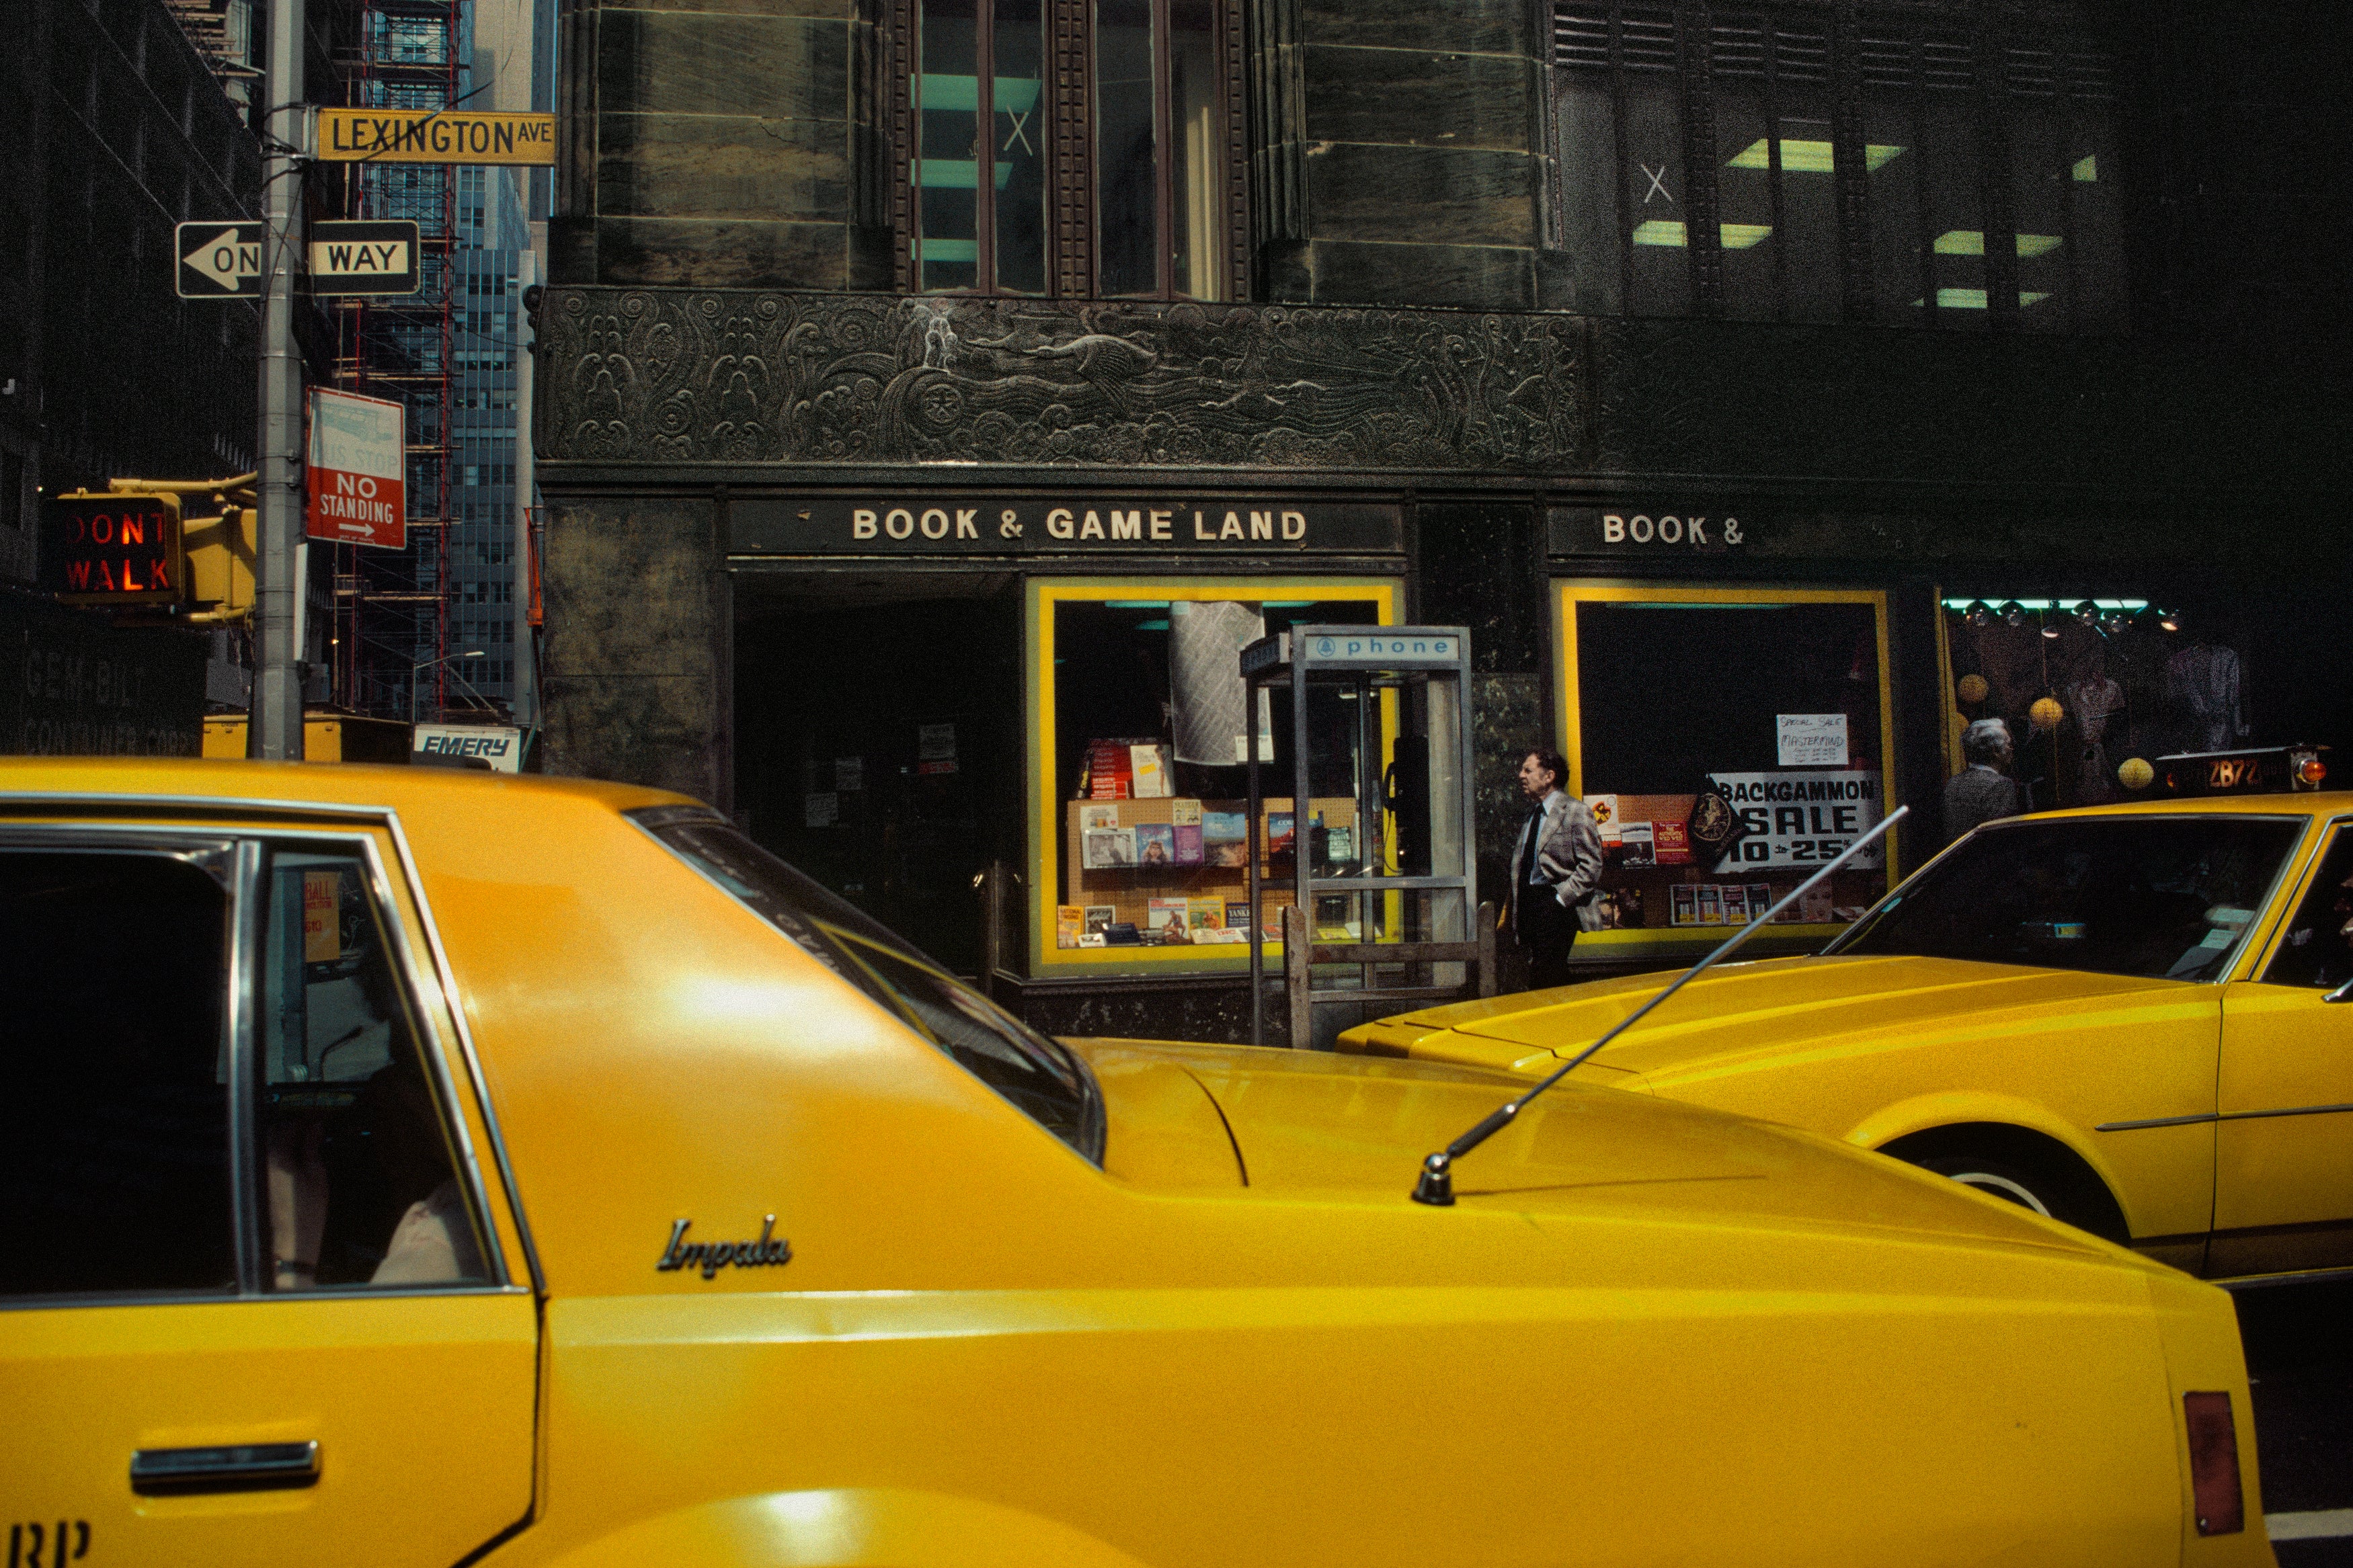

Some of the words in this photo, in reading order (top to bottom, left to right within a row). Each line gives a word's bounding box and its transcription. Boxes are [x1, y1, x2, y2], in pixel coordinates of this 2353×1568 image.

[333, 118, 514, 154] LEXINGTON
[516, 122, 553, 142] AVE
[214, 245, 260, 273] ON
[328, 244, 399, 272] WAY
[337, 472, 378, 499] NO
[319, 493, 395, 524] STANDING
[66, 513, 165, 545] DONT
[853, 509, 979, 540] BOOK
[1000, 508, 1023, 539] &
[1046, 508, 1172, 540] GAME
[1195, 510, 1306, 541] LAND
[1603, 514, 1708, 545] BOOK
[1724, 517, 1743, 545] &
[65, 559, 169, 591] WALK
[1347, 638, 1448, 656] phone
[1819, 716, 1843, 727] SALE
[422, 735, 511, 756] EMERY
[1781, 734, 1845, 747] MASTERMIND
[1719, 780, 1875, 802] BACKGAMMON
[1740, 806, 1860, 835] SALE
[1729, 841, 1770, 863] 10
[655, 1213, 793, 1280] Impala
